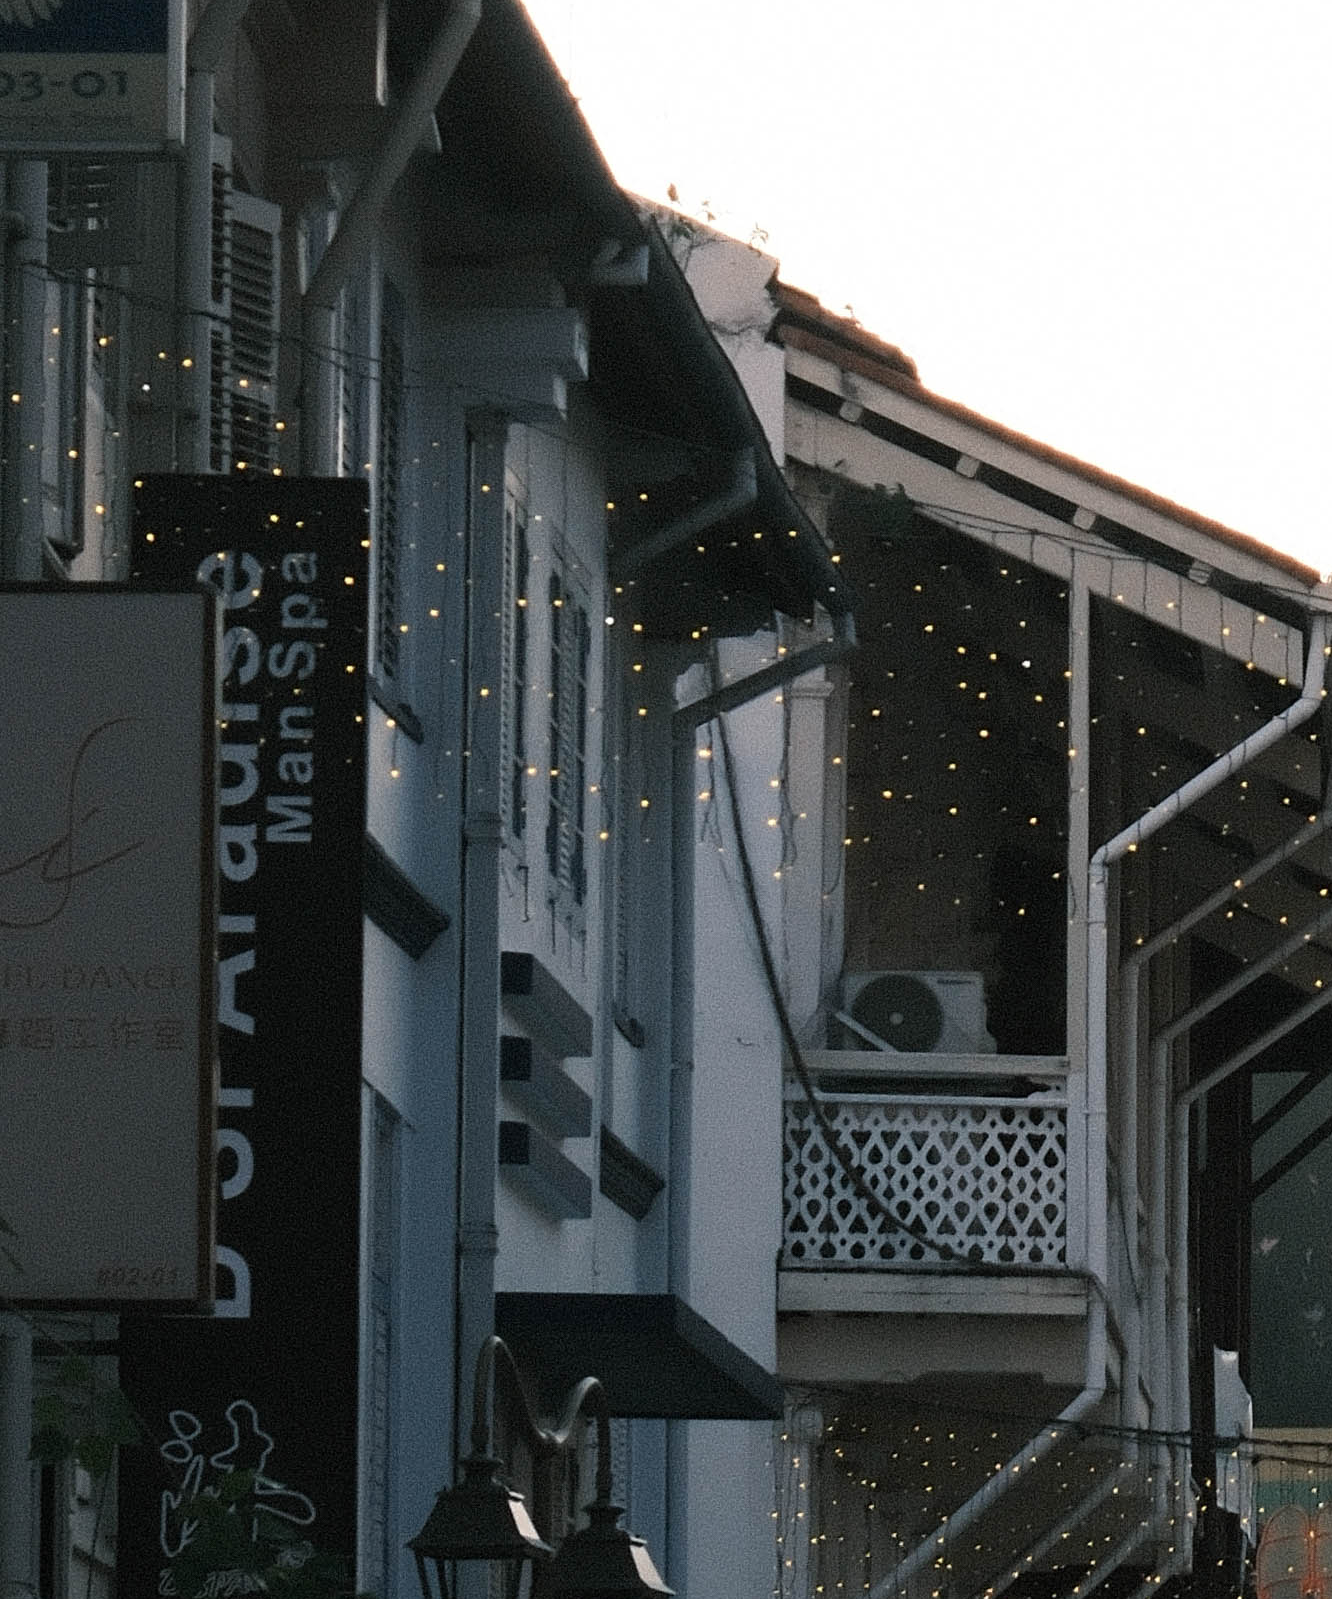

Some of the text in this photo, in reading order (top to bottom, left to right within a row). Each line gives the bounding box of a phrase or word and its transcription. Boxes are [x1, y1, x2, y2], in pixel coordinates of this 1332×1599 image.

[266, 550, 328, 845] Man Spa
[0, 1016, 185, 1051] 蹈工作室
